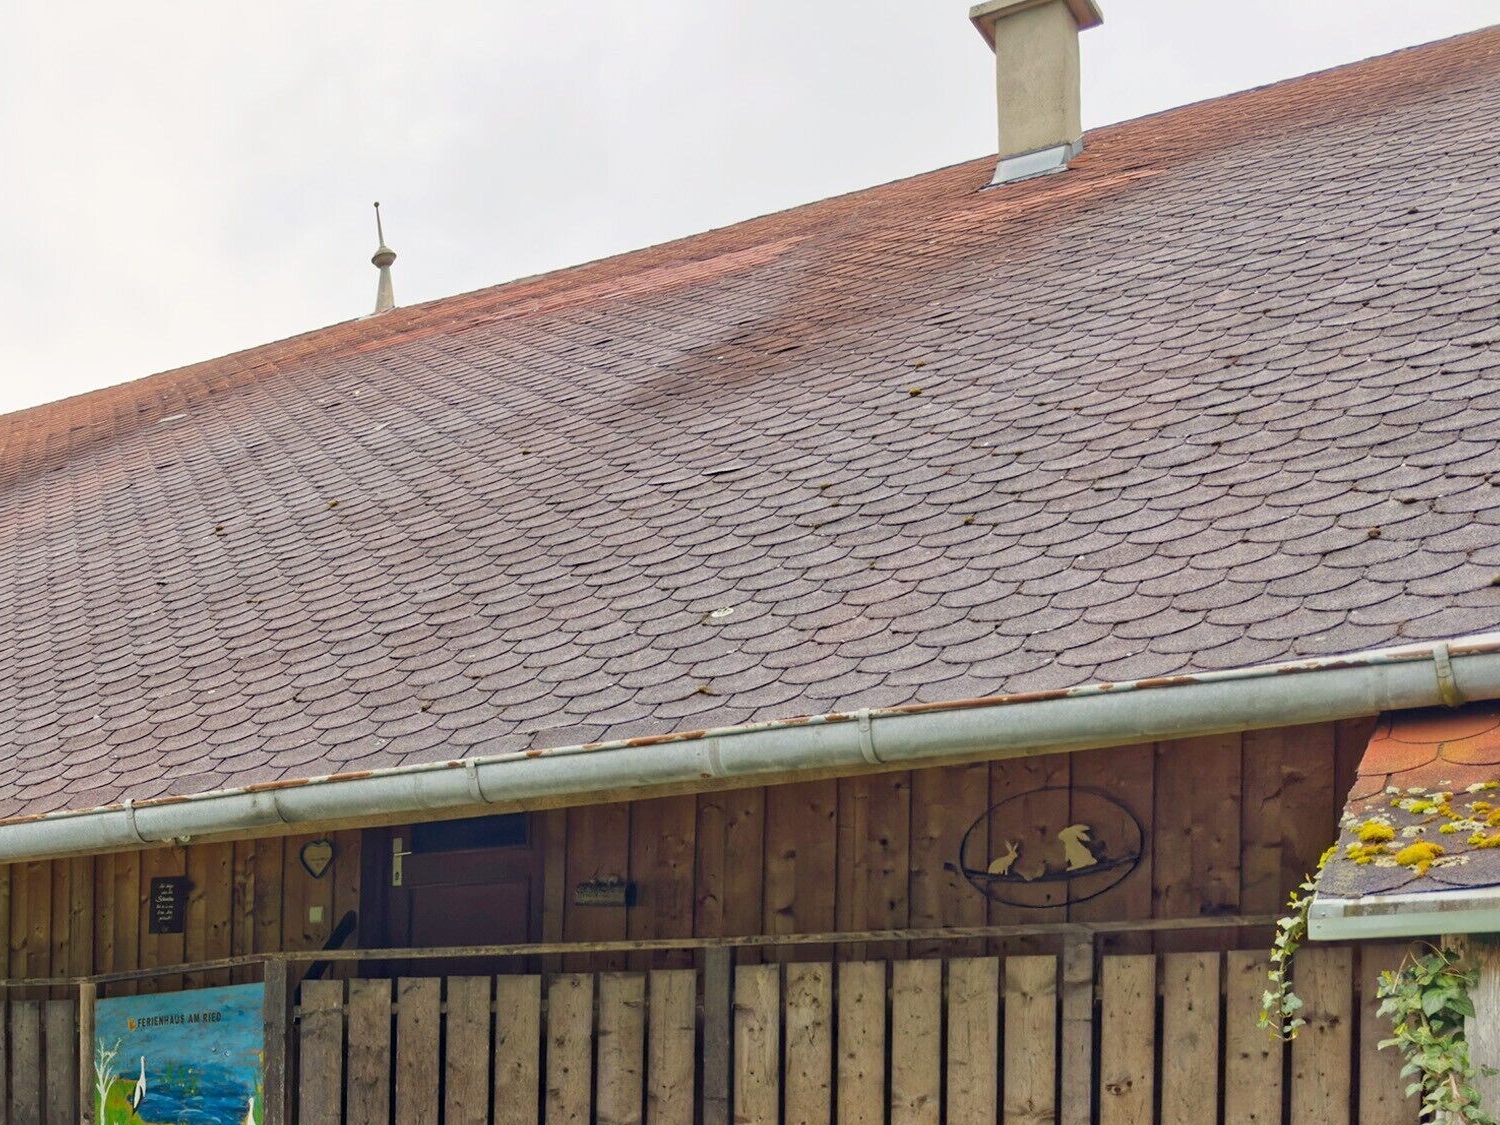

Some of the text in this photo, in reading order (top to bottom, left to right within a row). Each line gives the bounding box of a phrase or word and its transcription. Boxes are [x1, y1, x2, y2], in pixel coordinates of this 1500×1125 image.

[137, 1012, 222, 1028] FERIENHAUS AM RIED
